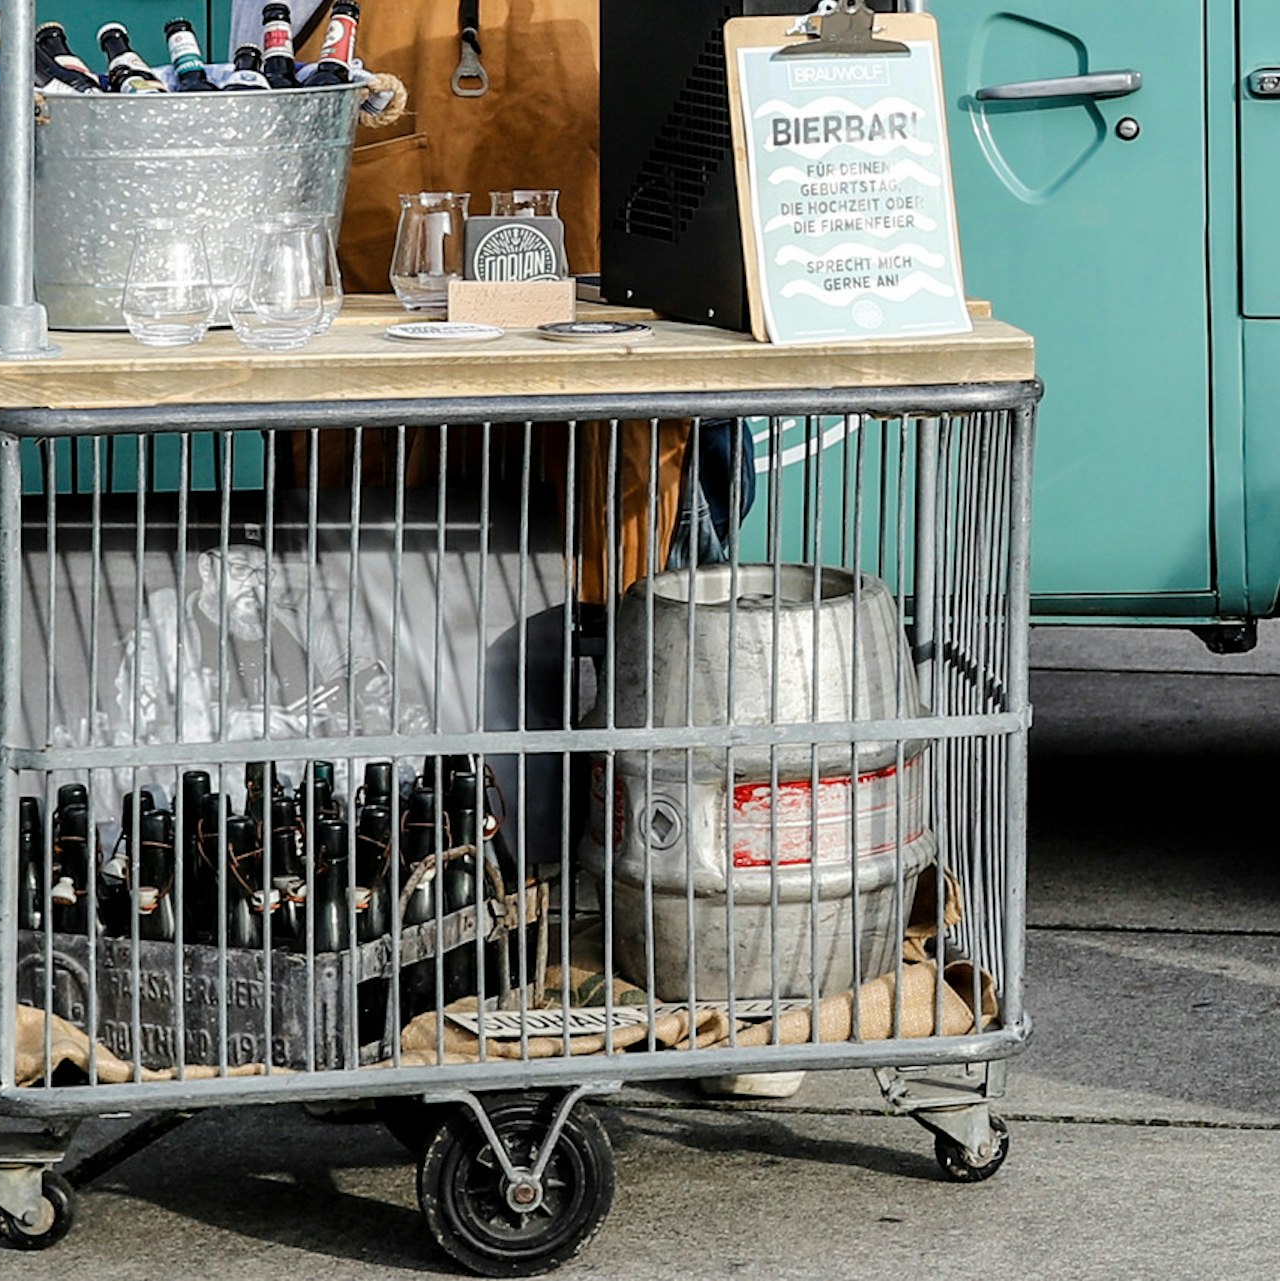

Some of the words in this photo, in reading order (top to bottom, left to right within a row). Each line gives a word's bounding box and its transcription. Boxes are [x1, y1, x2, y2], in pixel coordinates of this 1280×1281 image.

[795, 63, 882, 83] BRAUWOLF
[772, 111, 917, 146] BIERBAR!
[806, 162, 834, 177] FÜR
[840, 161, 891, 176] DEINEN
[781, 202, 803, 216] DIE
[808, 198, 880, 215] HOCHZEIT
[885, 196, 925, 210] ODER
[794, 220, 815, 234] DIE
[821, 215, 915, 232] FIRMENFEIER
[806, 258, 871, 274] SPRECHT
[878, 256, 912, 270] MICH
[824, 276, 871, 291] GERNE
[877, 274, 899, 287] AN!
